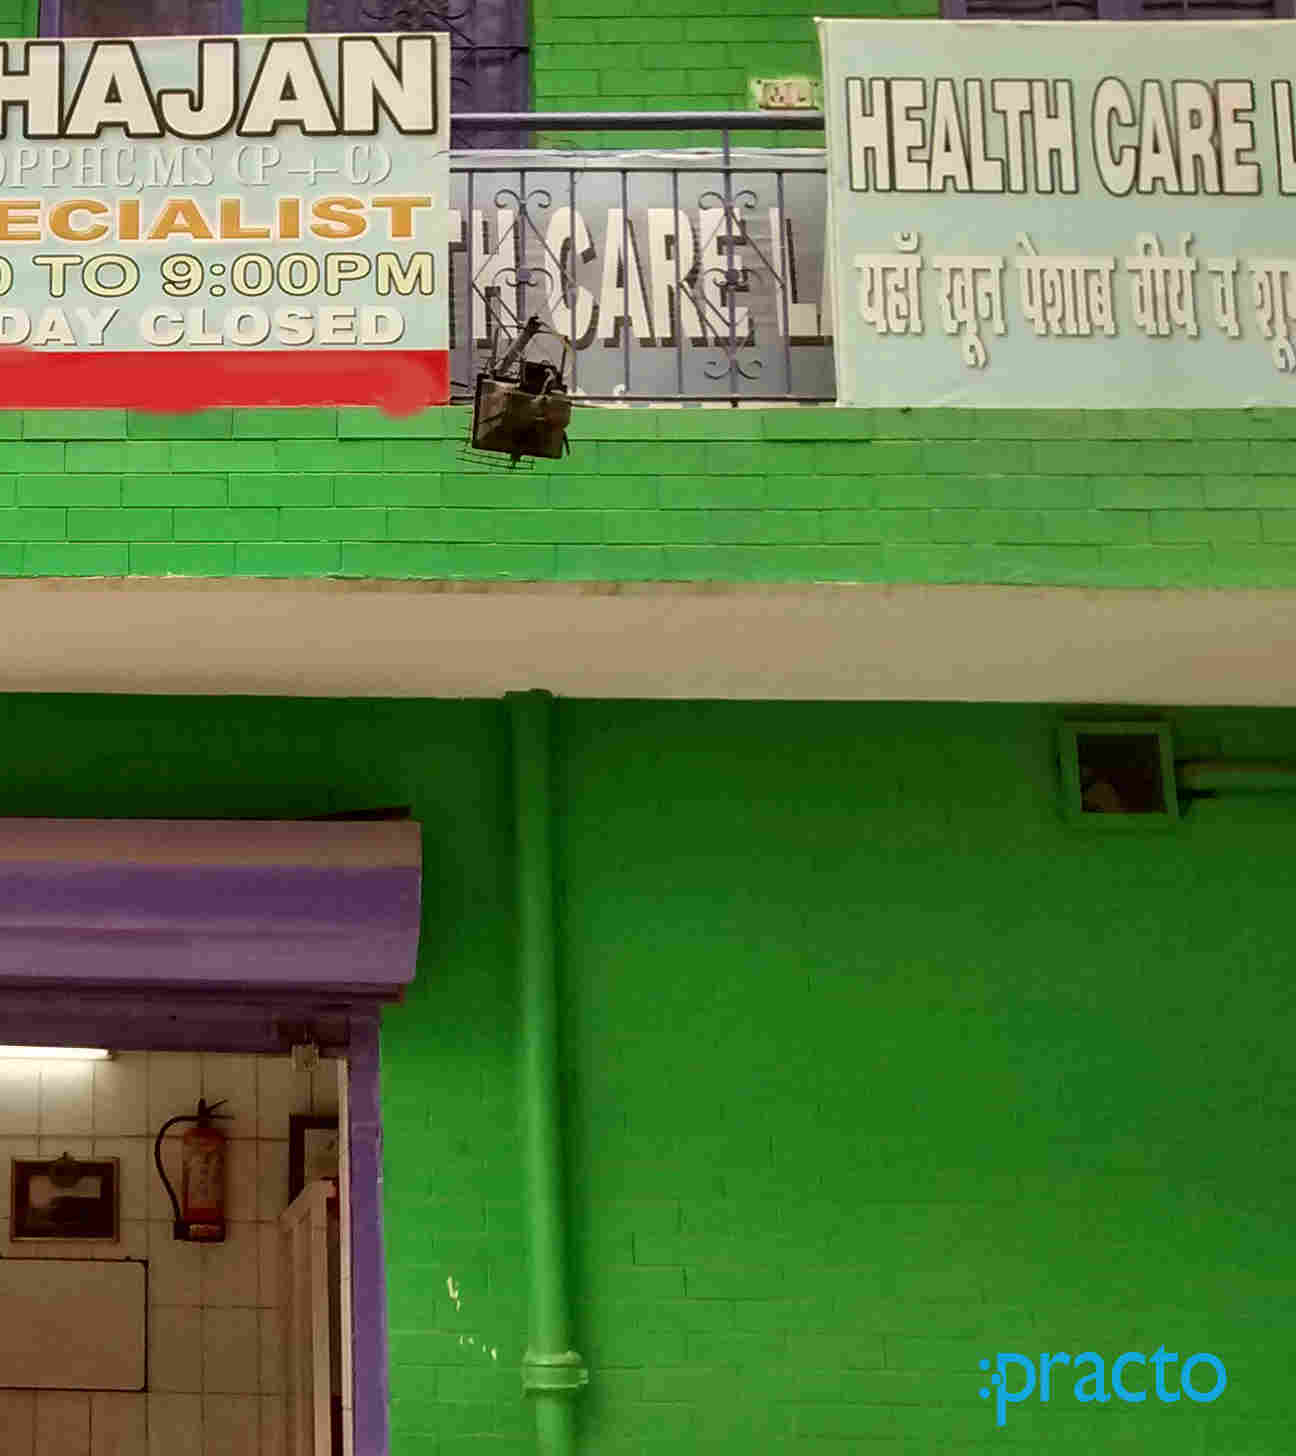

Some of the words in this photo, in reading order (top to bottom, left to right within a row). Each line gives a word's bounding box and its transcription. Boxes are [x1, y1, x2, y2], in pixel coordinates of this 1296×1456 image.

[845, 77, 1080, 195] HEALTH
[1091, 75, 1263, 198] CARE
[32, 253, 142, 298] TO
[159, 252, 436, 298] 9:00PM
[544, 205, 755, 350] CARE
[139, 304, 407, 347] CLOSED
